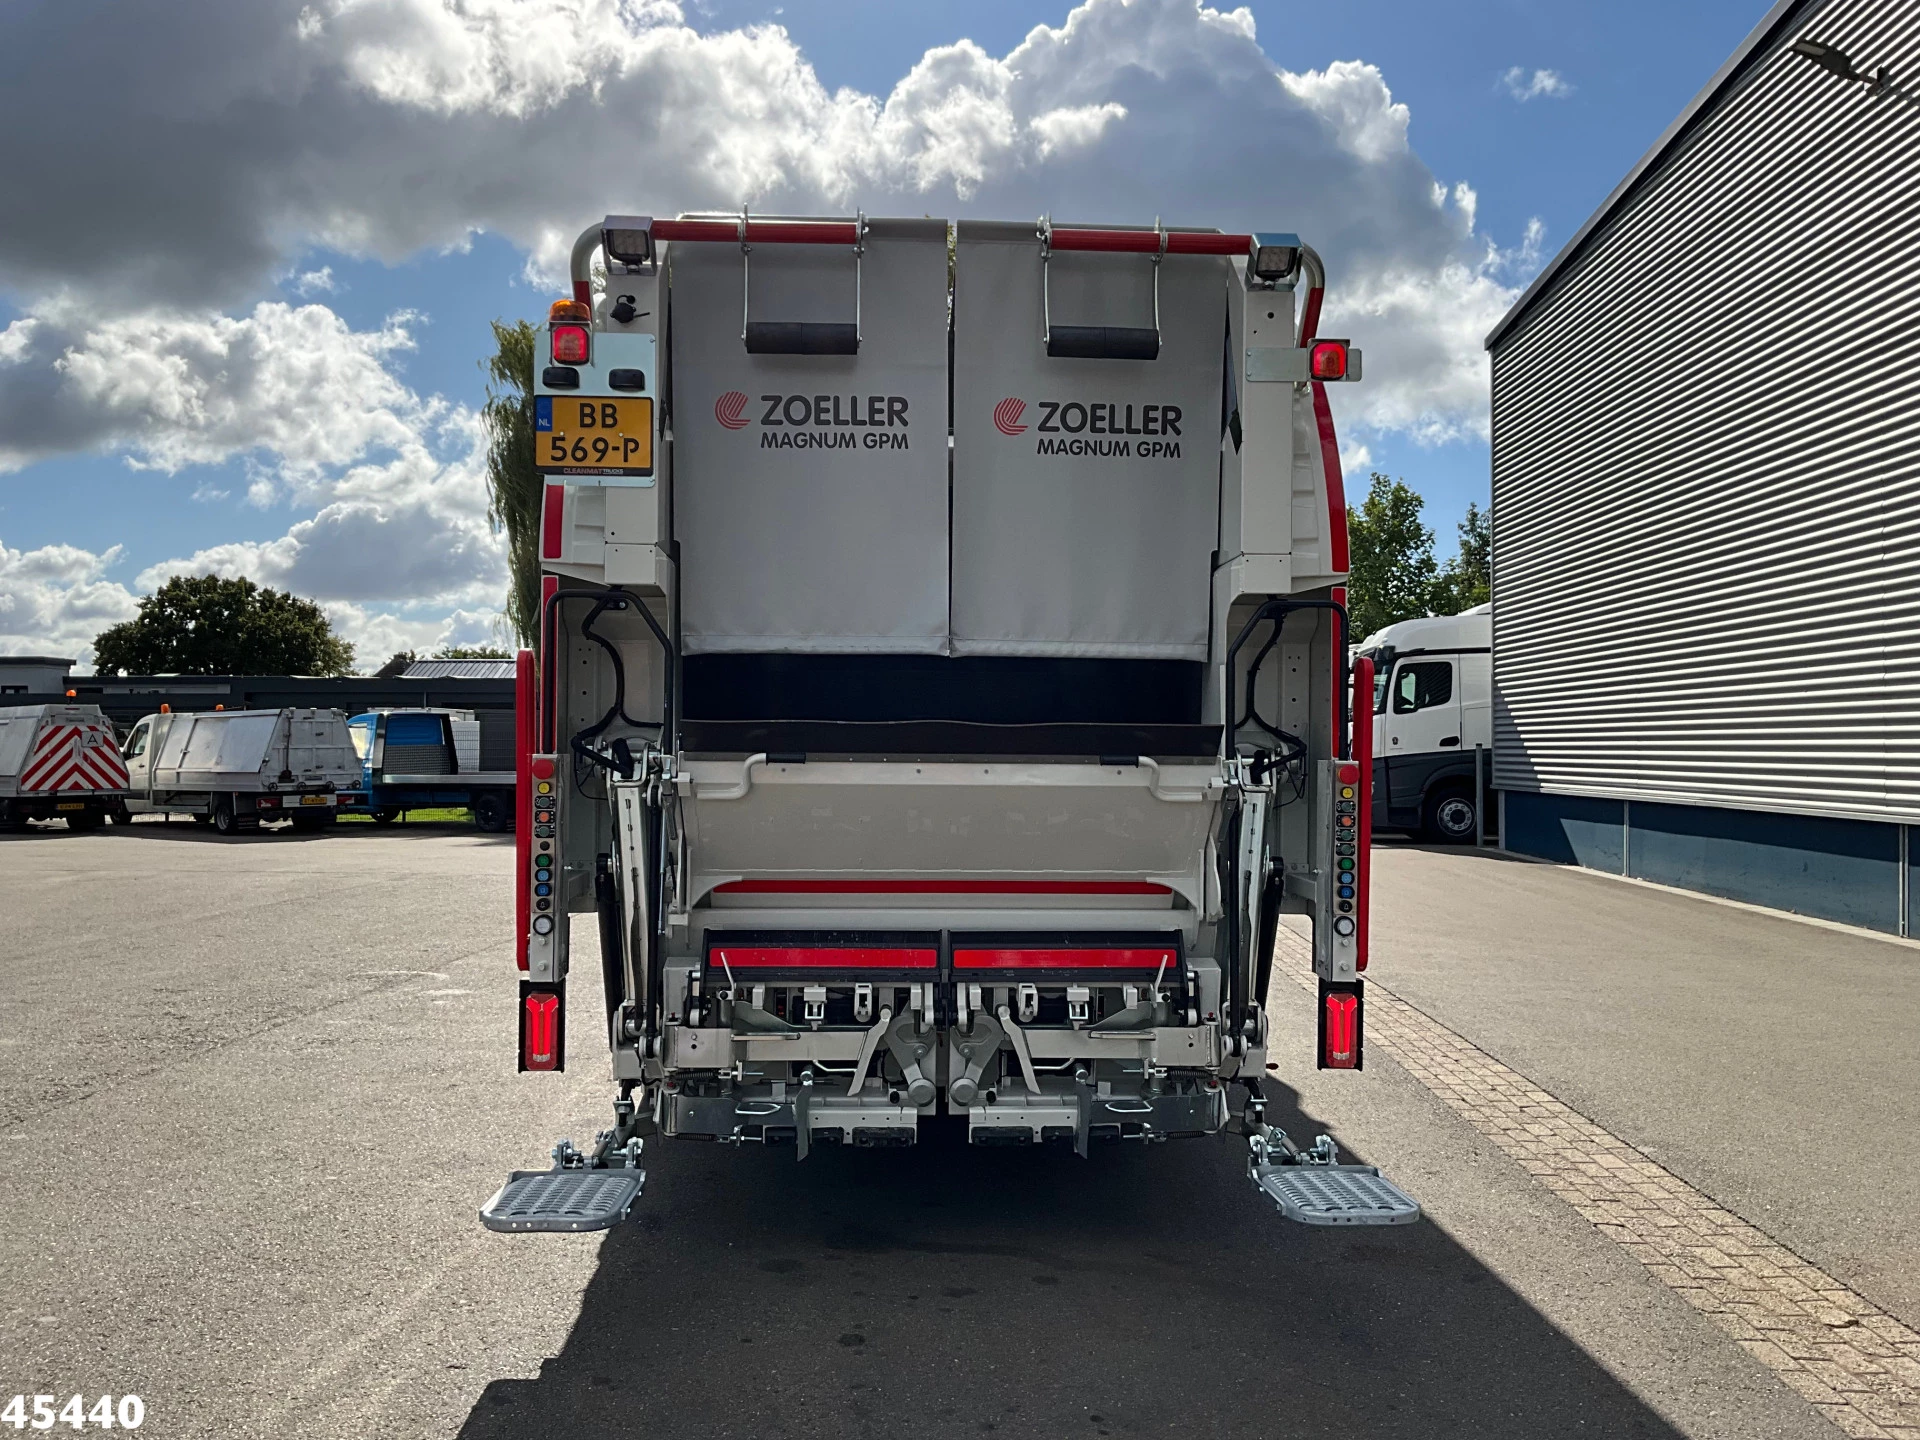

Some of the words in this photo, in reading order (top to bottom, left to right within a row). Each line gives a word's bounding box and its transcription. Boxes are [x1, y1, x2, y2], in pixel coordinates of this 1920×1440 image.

[538, 418, 551, 427] NL
[579, 402, 618, 428] BB
[760, 395, 909, 427] ZOELLER
[1038, 401, 1182, 436] ZOELLER
[550, 436, 640, 463] 569-P
[760, 432, 857, 449] MAGNUM
[863, 433, 909, 449] GPM
[1036, 438, 1131, 457] MAGNUM
[1136, 441, 1181, 458] GPM
[87, 733, 99, 745] A
